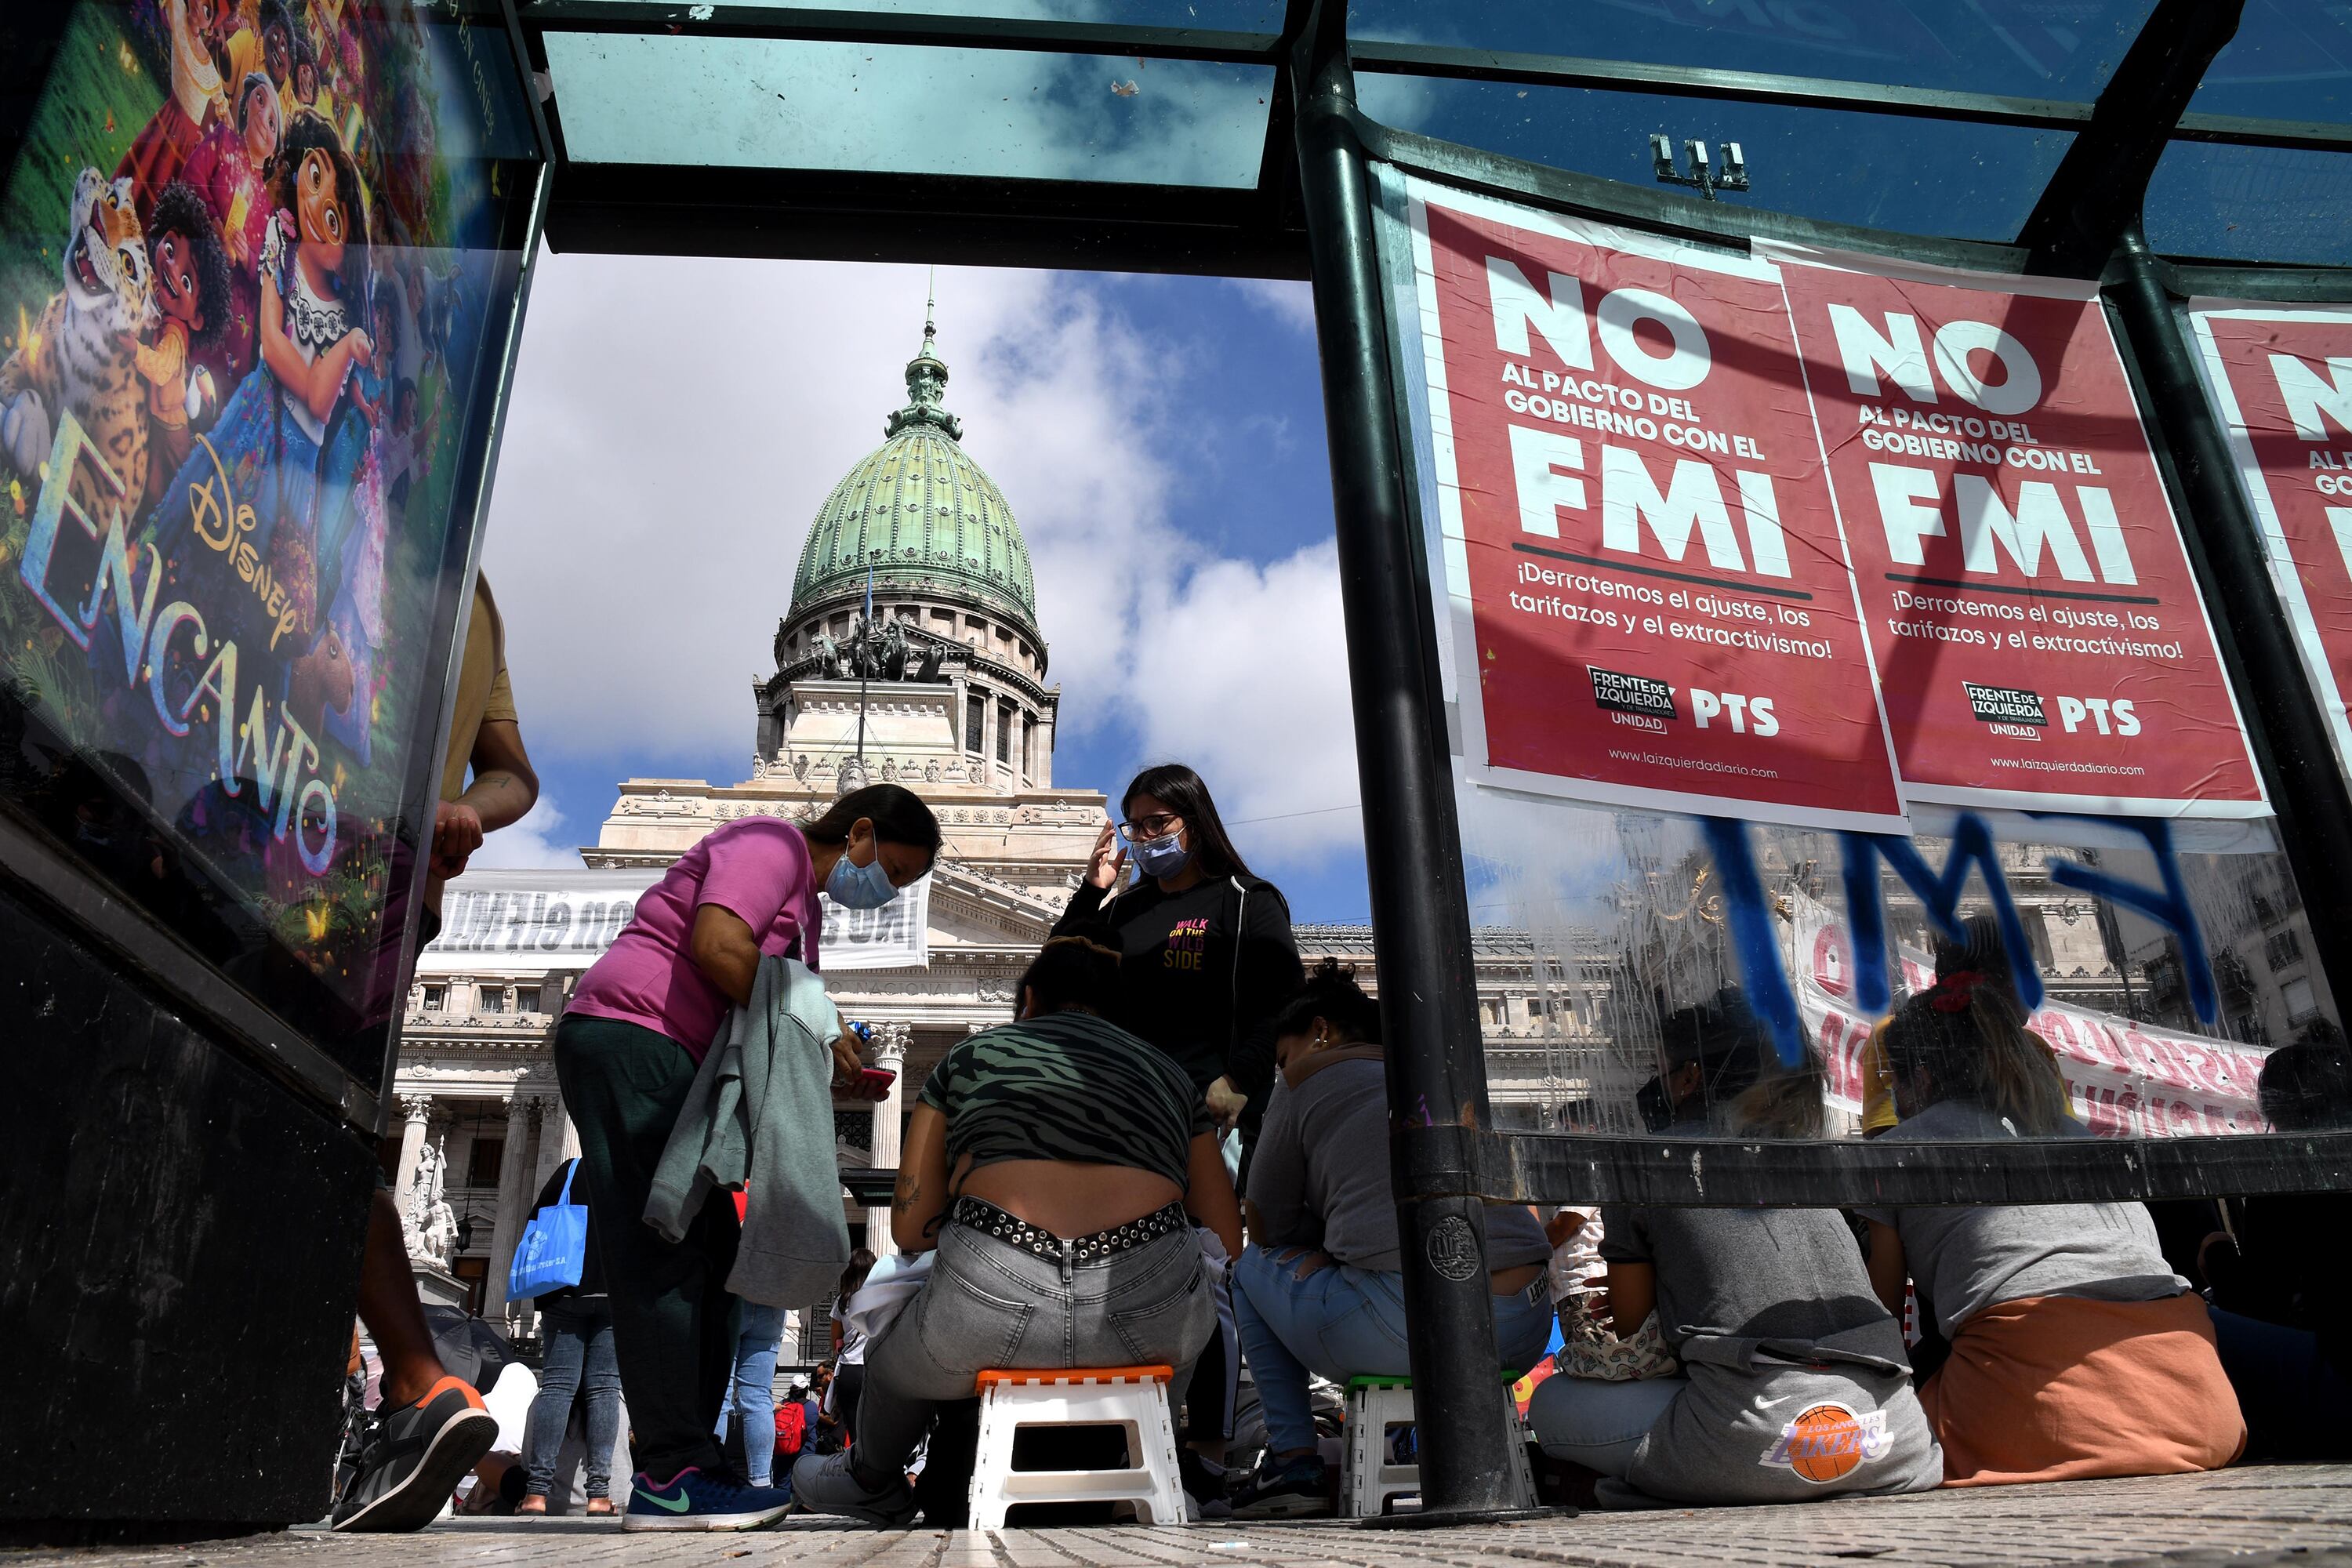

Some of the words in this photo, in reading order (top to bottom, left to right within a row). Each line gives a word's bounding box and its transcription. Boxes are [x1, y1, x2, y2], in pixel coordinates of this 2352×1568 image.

[458, 13, 474, 61] EN
[473, 60, 495, 136] CINES
[1485, 255, 1711, 390] NO
[1827, 303, 2042, 416] NO
[1501, 361, 1539, 389] AL
[1543, 371, 1643, 412] PACTO
[1647, 393, 1700, 423] DEL
[1504, 390, 1657, 440] GOBIERNO
[1662, 423, 1729, 455] CON
[1733, 434, 1765, 461] EL
[1859, 404, 1890, 426] AL
[1893, 408, 1986, 438] PACTO
[1988, 419, 2038, 445] DEL
[1862, 429, 2001, 465] GOBIERNO
[2005, 447, 2068, 472] CON
[2069, 452, 2102, 475] EL
[2310, 450, 2343, 470] AL
[1508, 423, 1791, 579] FMI
[1868, 461, 2138, 586] FMI
[1518, 561, 1663, 605] ¡Derrotemos
[1668, 589, 1690, 609] el
[1695, 593, 1773, 625] ajuste,
[1777, 604, 1810, 627] los
[1892, 590, 2024, 621] ¡Derrotemos
[2028, 604, 2048, 622] el
[2053, 605, 2125, 630] ajuste,
[2128, 611, 2160, 630] los
[1509, 590, 1617, 627] tarifazos
[1624, 614, 1636, 633] y
[1642, 615, 1663, 635] el
[1669, 622, 1832, 659] extractivismo!
[1887, 617, 1986, 645] tarifazos
[1989, 630, 2002, 650] y
[2008, 630, 2027, 648] el
[2032, 635, 2183, 659] extractivismo!
[1592, 671, 1650, 693] FRENTE
[1650, 683, 1665, 695] DE
[1595, 687, 1673, 710] IZQUIERDA
[1968, 687, 2021, 704] FRENTE
[2021, 695, 2036, 705] DE
[1611, 712, 1663, 730] UNIDAD
[1635, 706, 1675, 717] TRABAJADORES
[1690, 688, 1779, 737] PTS
[1972, 700, 2044, 717] IZQUIERDA
[2056, 696, 2141, 736] PTS
[1989, 724, 2036, 737] UNIDAD
[1609, 749, 1779, 779] www.laizquierdadiario.com
[1991, 757, 2145, 776] www.laizquierdadiario.com
[1169, 928, 1183, 937] ON
[1186, 928, 1205, 937] THE
[1176, 918, 1209, 930] WALK
[1163, 949, 1203, 970] SIDE
[1169, 936, 1204, 952] WILD
[856, 982, 958, 997] NACIONAL
[1807, 1424, 1831, 1433] LOS
[1831, 1414, 1880, 1430] ANGELES
[1769, 1425, 1880, 1464] LAKERS
